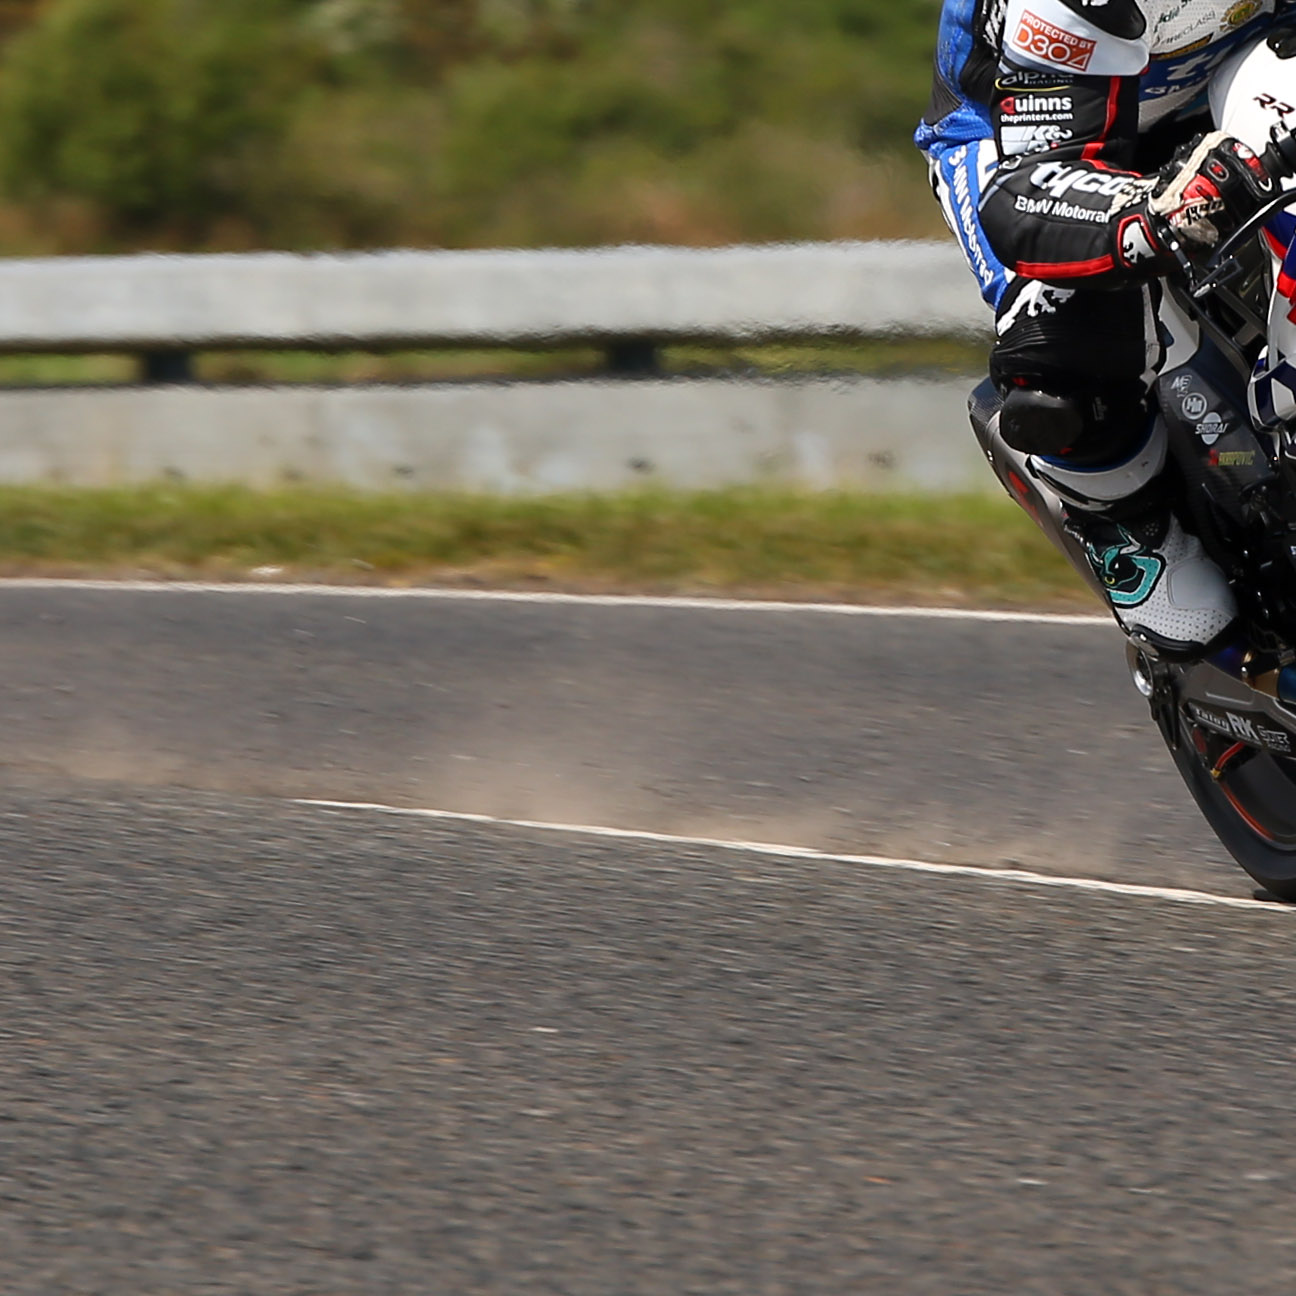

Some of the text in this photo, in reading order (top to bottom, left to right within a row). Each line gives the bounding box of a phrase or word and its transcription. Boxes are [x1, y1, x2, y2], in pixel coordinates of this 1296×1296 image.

[1022, 12, 1095, 51] PROTECTED BY
[1000, 94, 1073, 115] Quinns
[1253, 93, 1295, 118] RR
[1000, 113, 1074, 123] theprinters.com
[1015, 195, 1053, 214] BMW
[1195, 423, 1229, 435] SHORAI
[1226, 711, 1260, 740] RK
